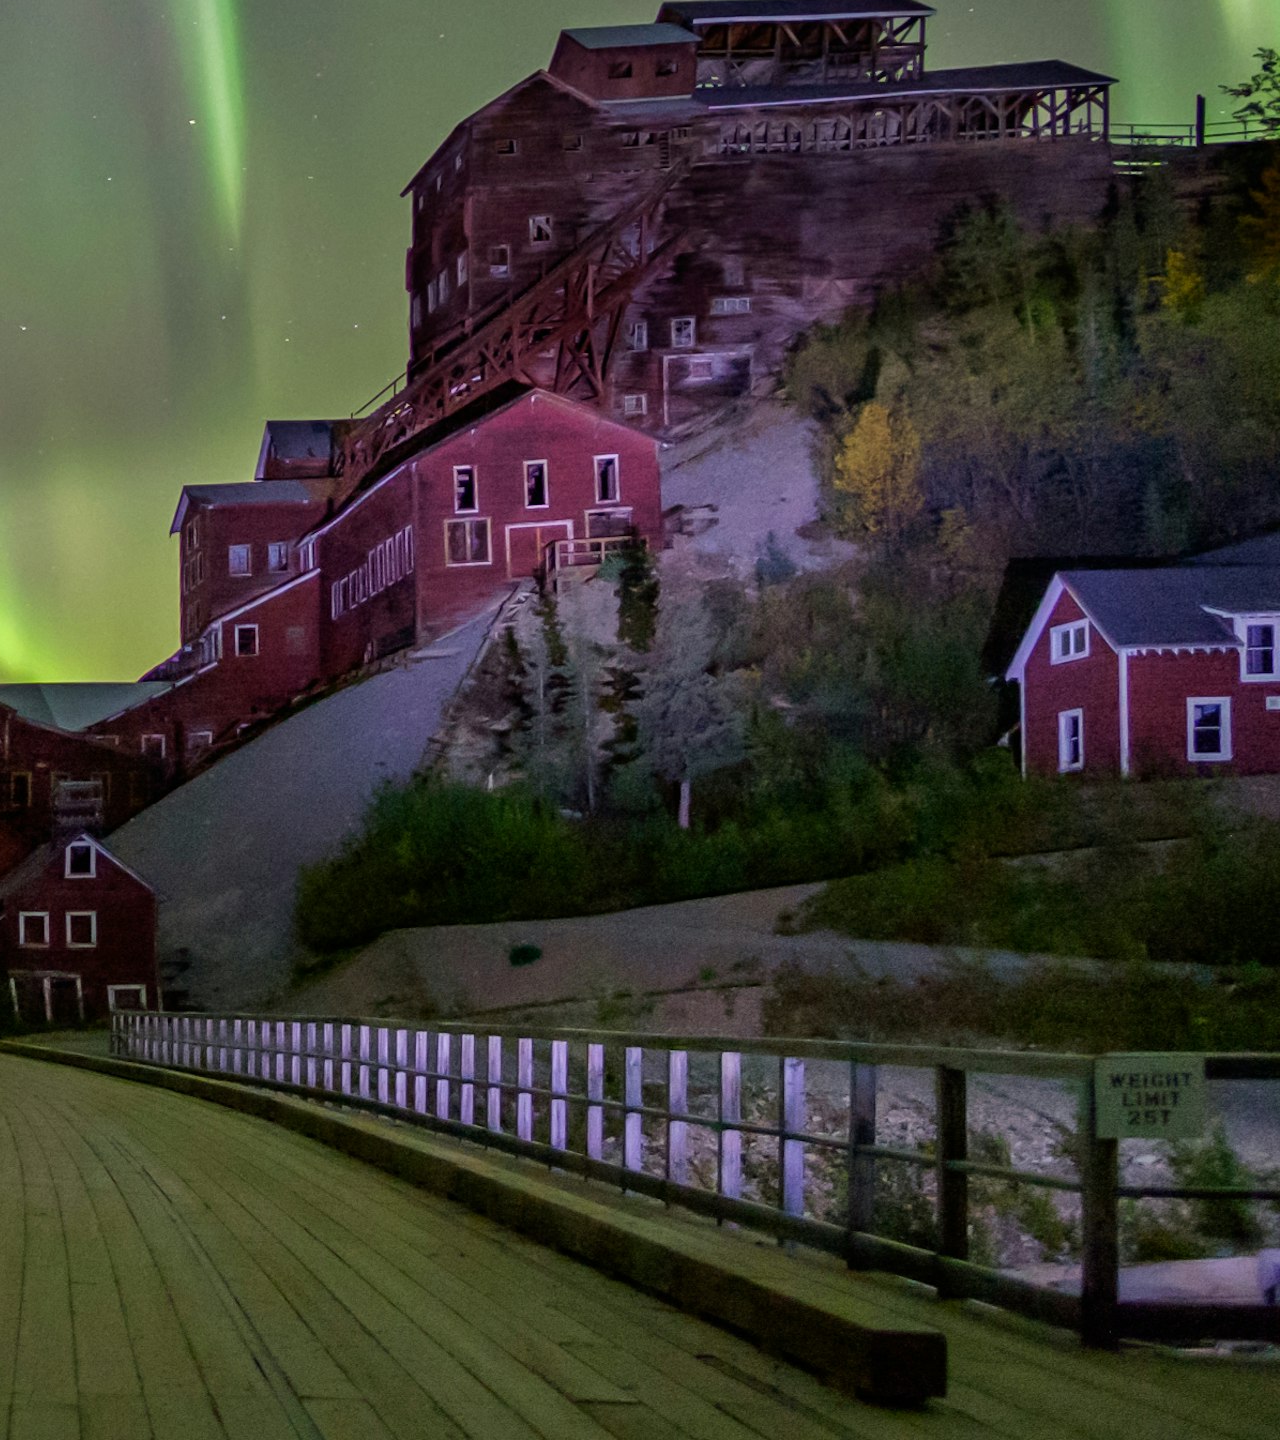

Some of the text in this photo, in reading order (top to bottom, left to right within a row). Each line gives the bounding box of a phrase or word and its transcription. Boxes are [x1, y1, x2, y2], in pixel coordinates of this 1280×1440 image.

[1110, 1072, 1192, 1088] WEIGHT
[1121, 1091, 1179, 1107] LIMIT
[1127, 1109, 1171, 1125] 25T
